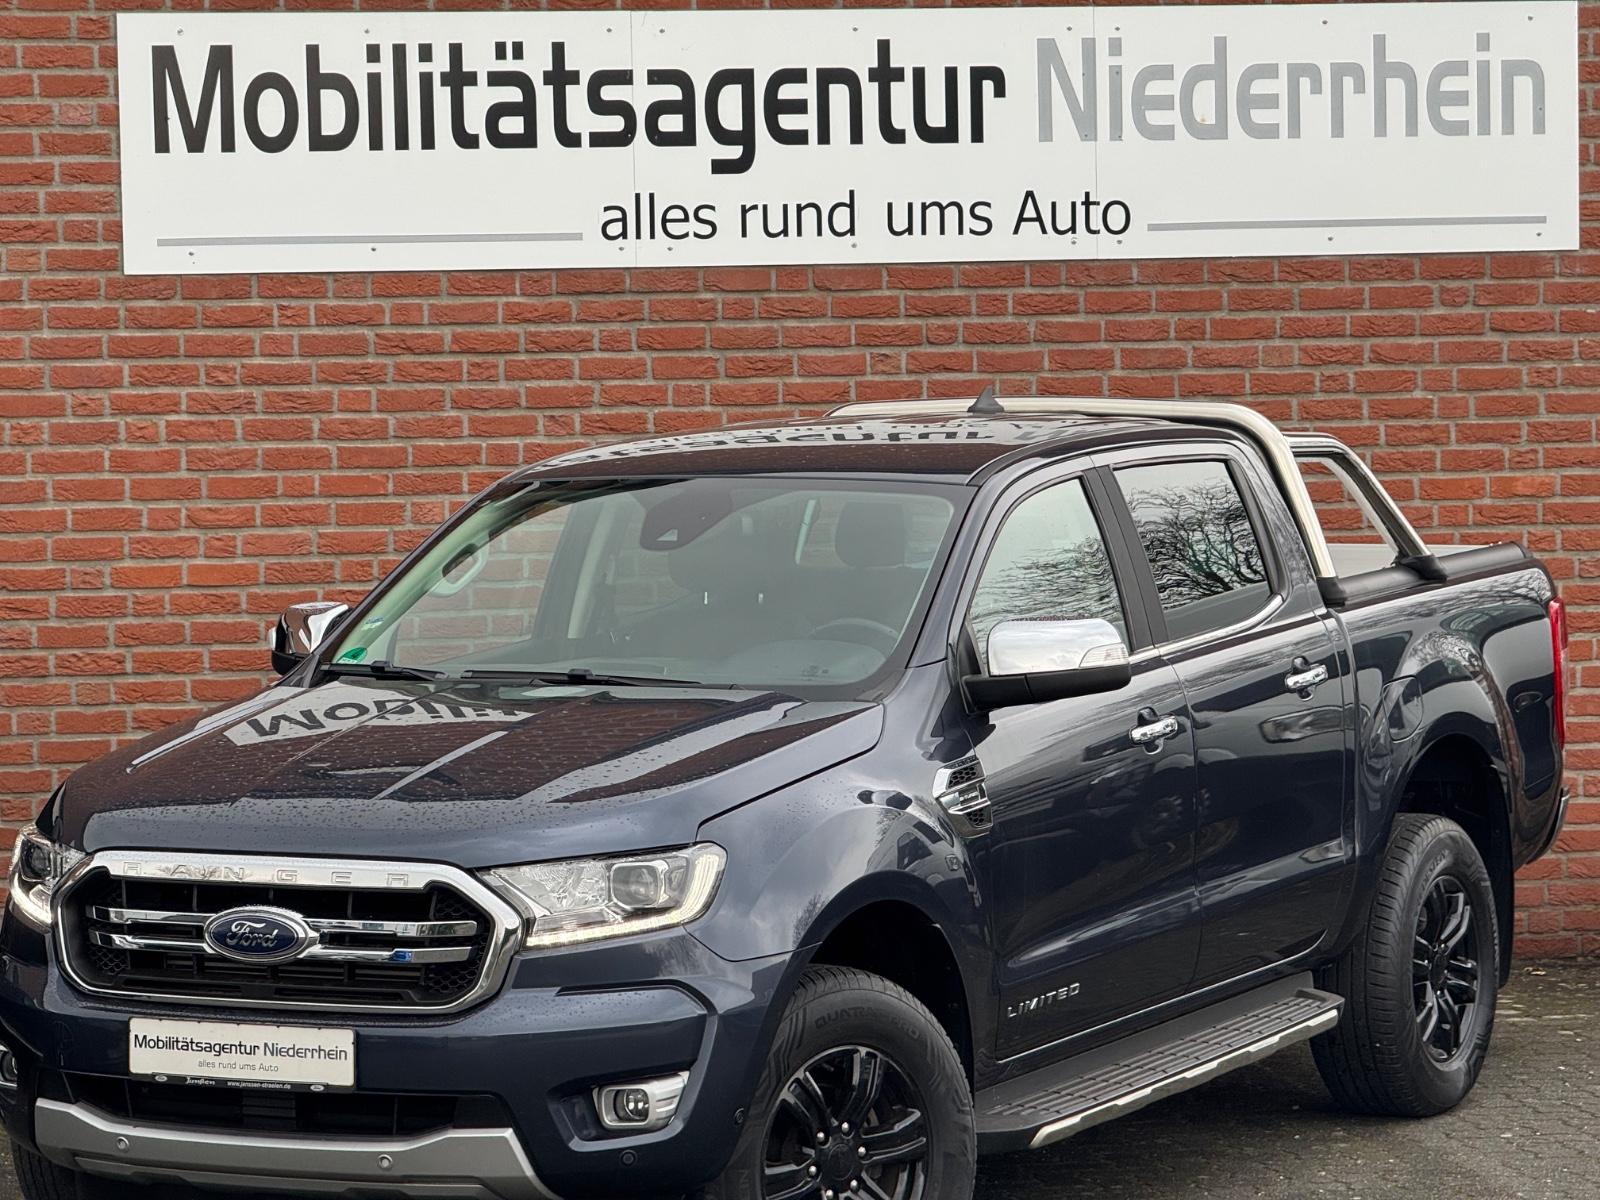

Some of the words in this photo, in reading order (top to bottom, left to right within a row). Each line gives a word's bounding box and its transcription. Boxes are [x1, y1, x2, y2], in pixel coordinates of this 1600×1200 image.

[152, 39, 1005, 174] Mobilitätsagentur
[1037, 33, 1545, 142] Niederrhein
[602, 193, 717, 240] alles
[741, 190, 855, 238] rund
[888, 201, 992, 236] ums
[1013, 191, 1130, 235] Auto
[122, 861, 409, 886] RANGER
[226, 920, 278, 947] Ford
[1007, 982, 1080, 1017] LIMITED
[134, 1034, 260, 1057] Mobilitätsagentur
[263, 1042, 348, 1061] Niederrhein
[198, 1059, 216, 1069] alles
[218, 1061, 237, 1070] rund
[239, 1063, 256, 1071] ums
[259, 1063, 279, 1072] Auto
